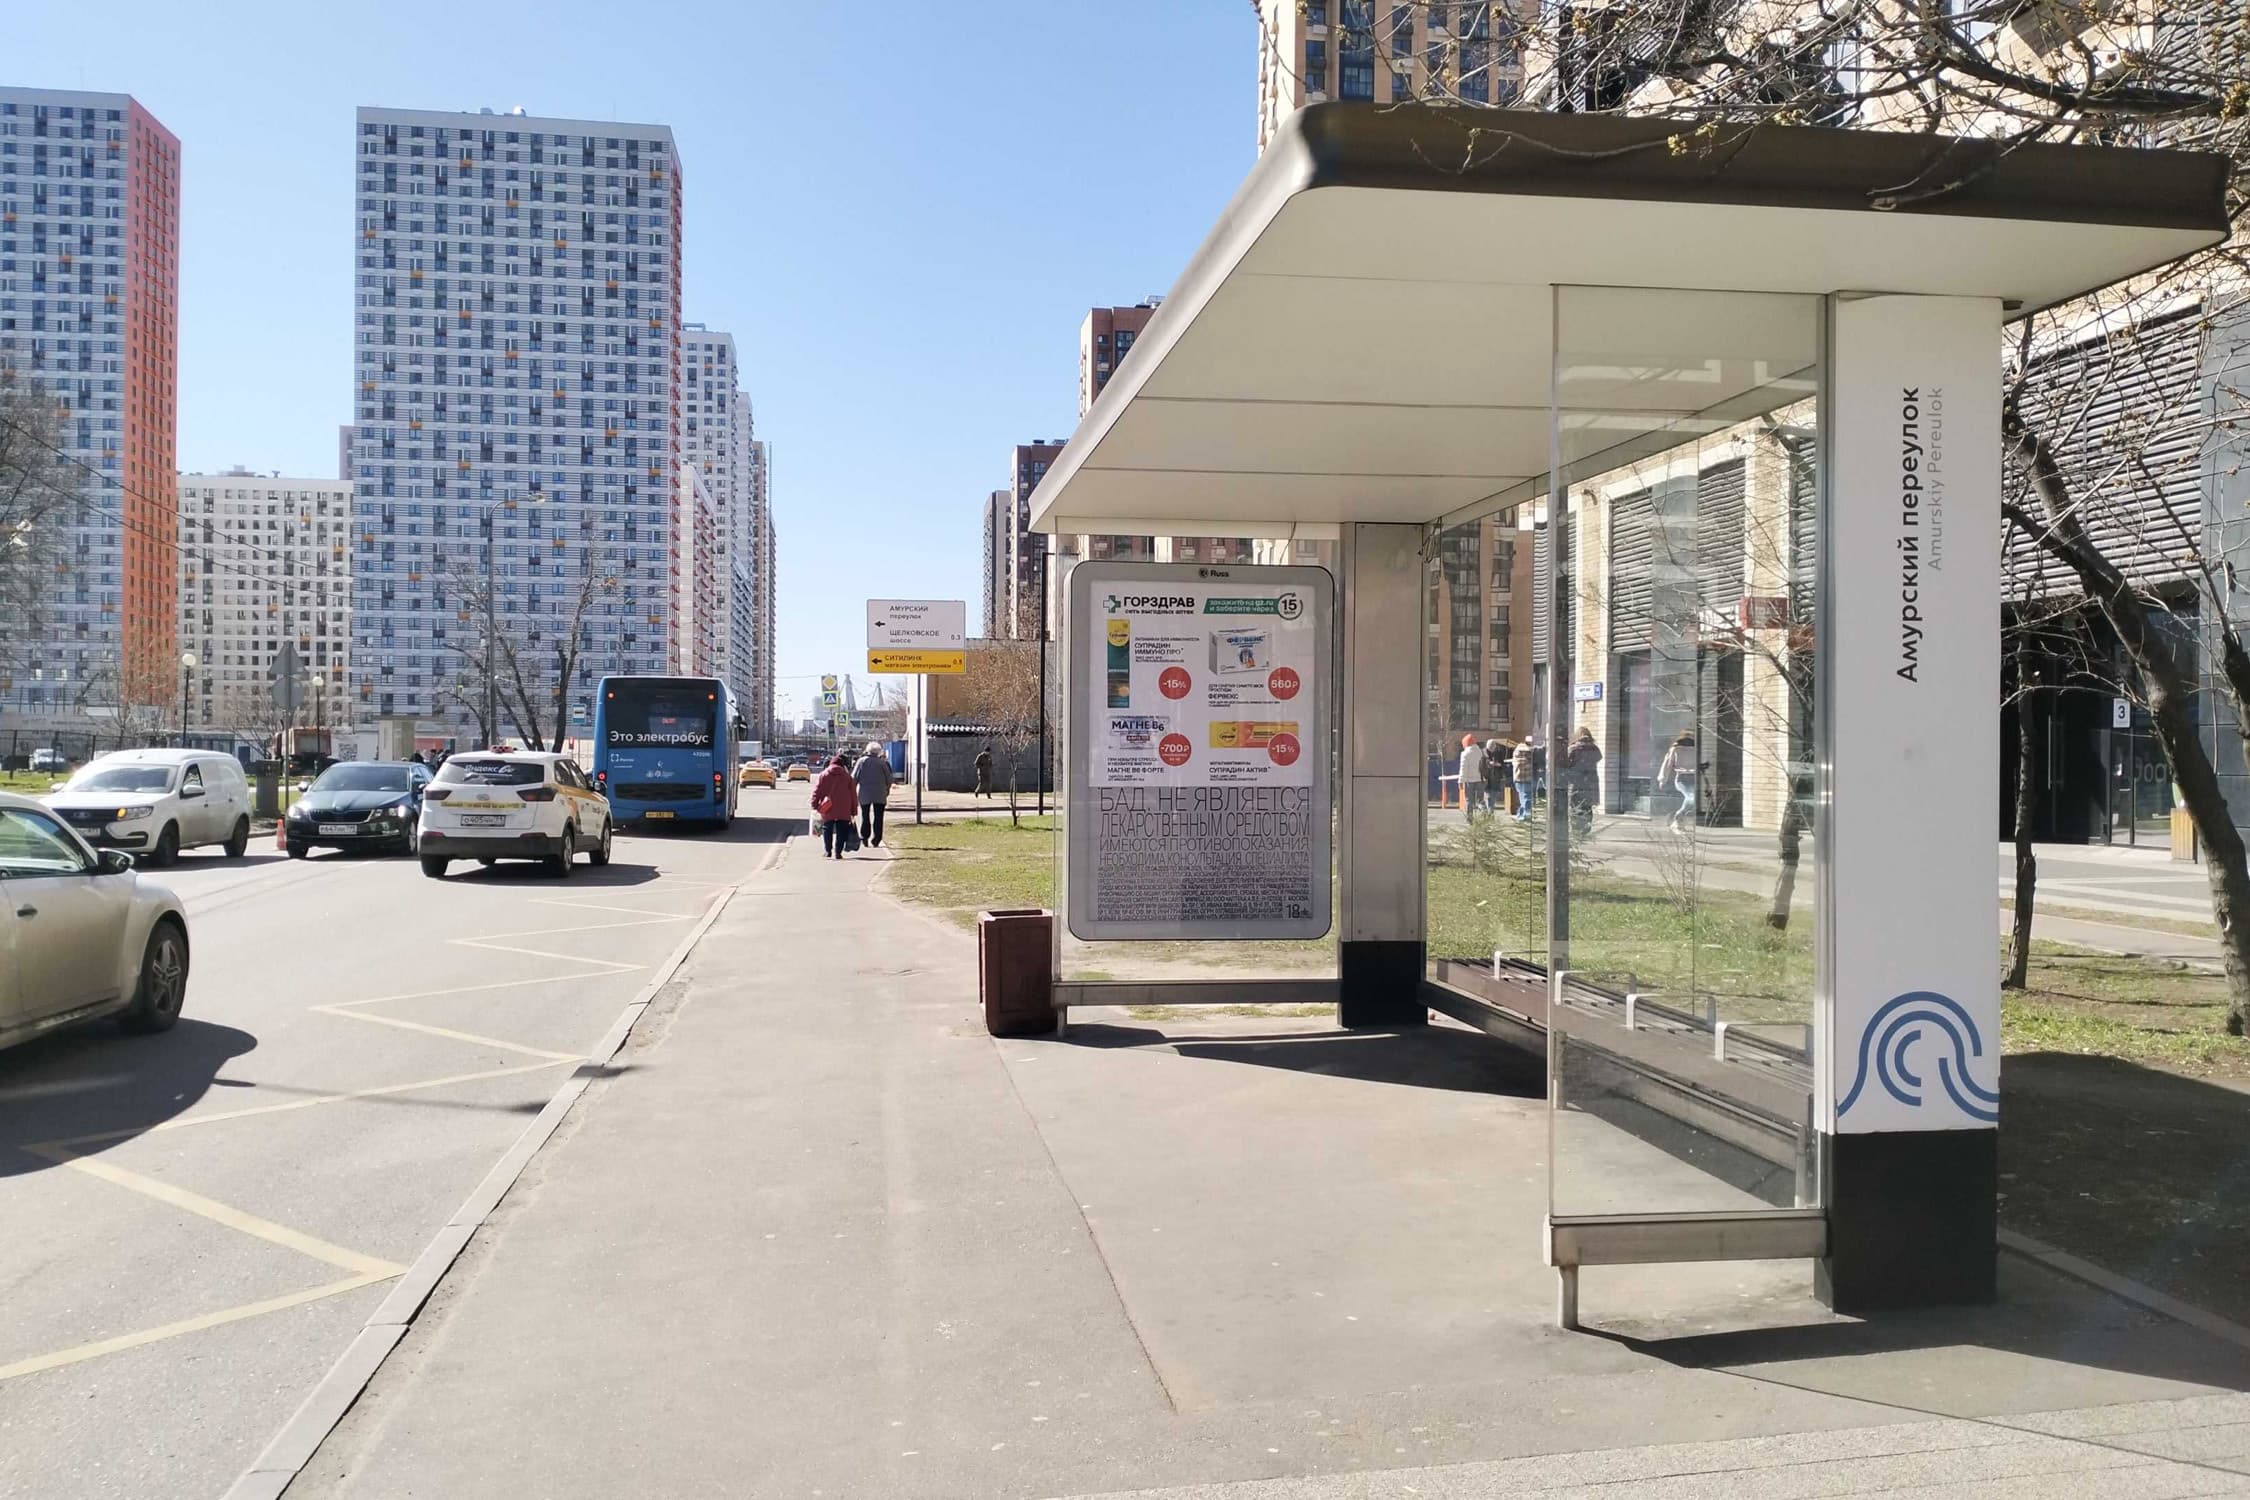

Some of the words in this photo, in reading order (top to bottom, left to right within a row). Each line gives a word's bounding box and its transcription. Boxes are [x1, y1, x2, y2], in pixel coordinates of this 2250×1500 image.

[1928, 387, 1942, 473] Pereulok
[1902, 387, 1923, 526] переулок
[1928, 478, 1944, 571] Amurskiy
[1210, 570, 1229, 578] Russ
[1123, 596, 1195, 609] ГОРЗДРАВ
[1281, 599, 1297, 611] 15
[1897, 537, 1923, 683] Амурский
[2118, 705, 2125, 719] 3
[1111, 720, 1152, 729] МАГНЕ
[610, 730, 634, 742] Это
[636, 731, 709, 745] электробус
[1158, 786, 1187, 811] НЕ
[1194, 786, 1310, 812] ЯВЛЯЕТСЯ
[1099, 812, 1223, 837] ЛЕКАРСТВЕННЫМ
[1225, 812, 1310, 837] СРЕДСТВОМ
[1099, 838, 1166, 851] ИМЕЮТСЯ
[1169, 838, 1310, 852] ПРОТИВОПОКАЗАНИЯ
[1099, 852, 1166, 866] НЕОБХОДИМА
[1167, 852, 1241, 866] КОНСУЛЬТАЦИЯ
[1244, 852, 1310, 866] СПЕЦИАЛИСТА
[1285, 903, 1309, 919] 18+
